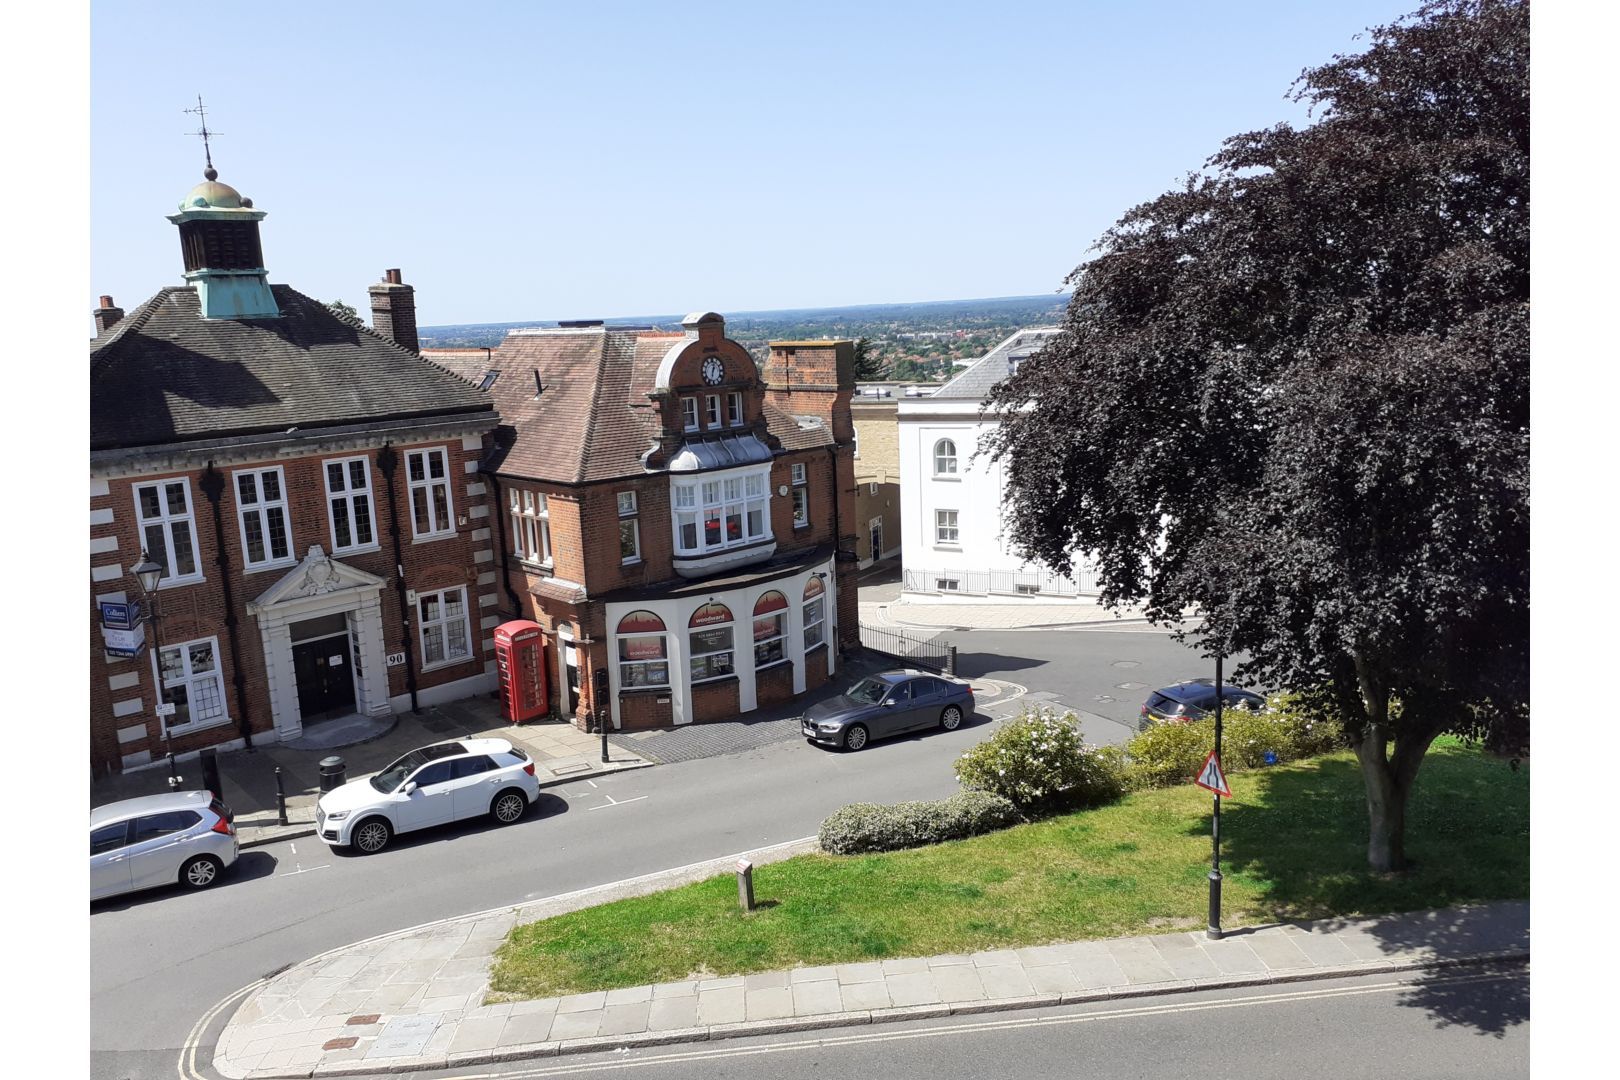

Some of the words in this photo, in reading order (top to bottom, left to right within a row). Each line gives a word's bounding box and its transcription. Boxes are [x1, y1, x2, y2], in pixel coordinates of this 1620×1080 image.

[105, 608, 126, 617] Colliers
[695, 614, 725, 623] woodward
[389, 654, 403, 665] 90
